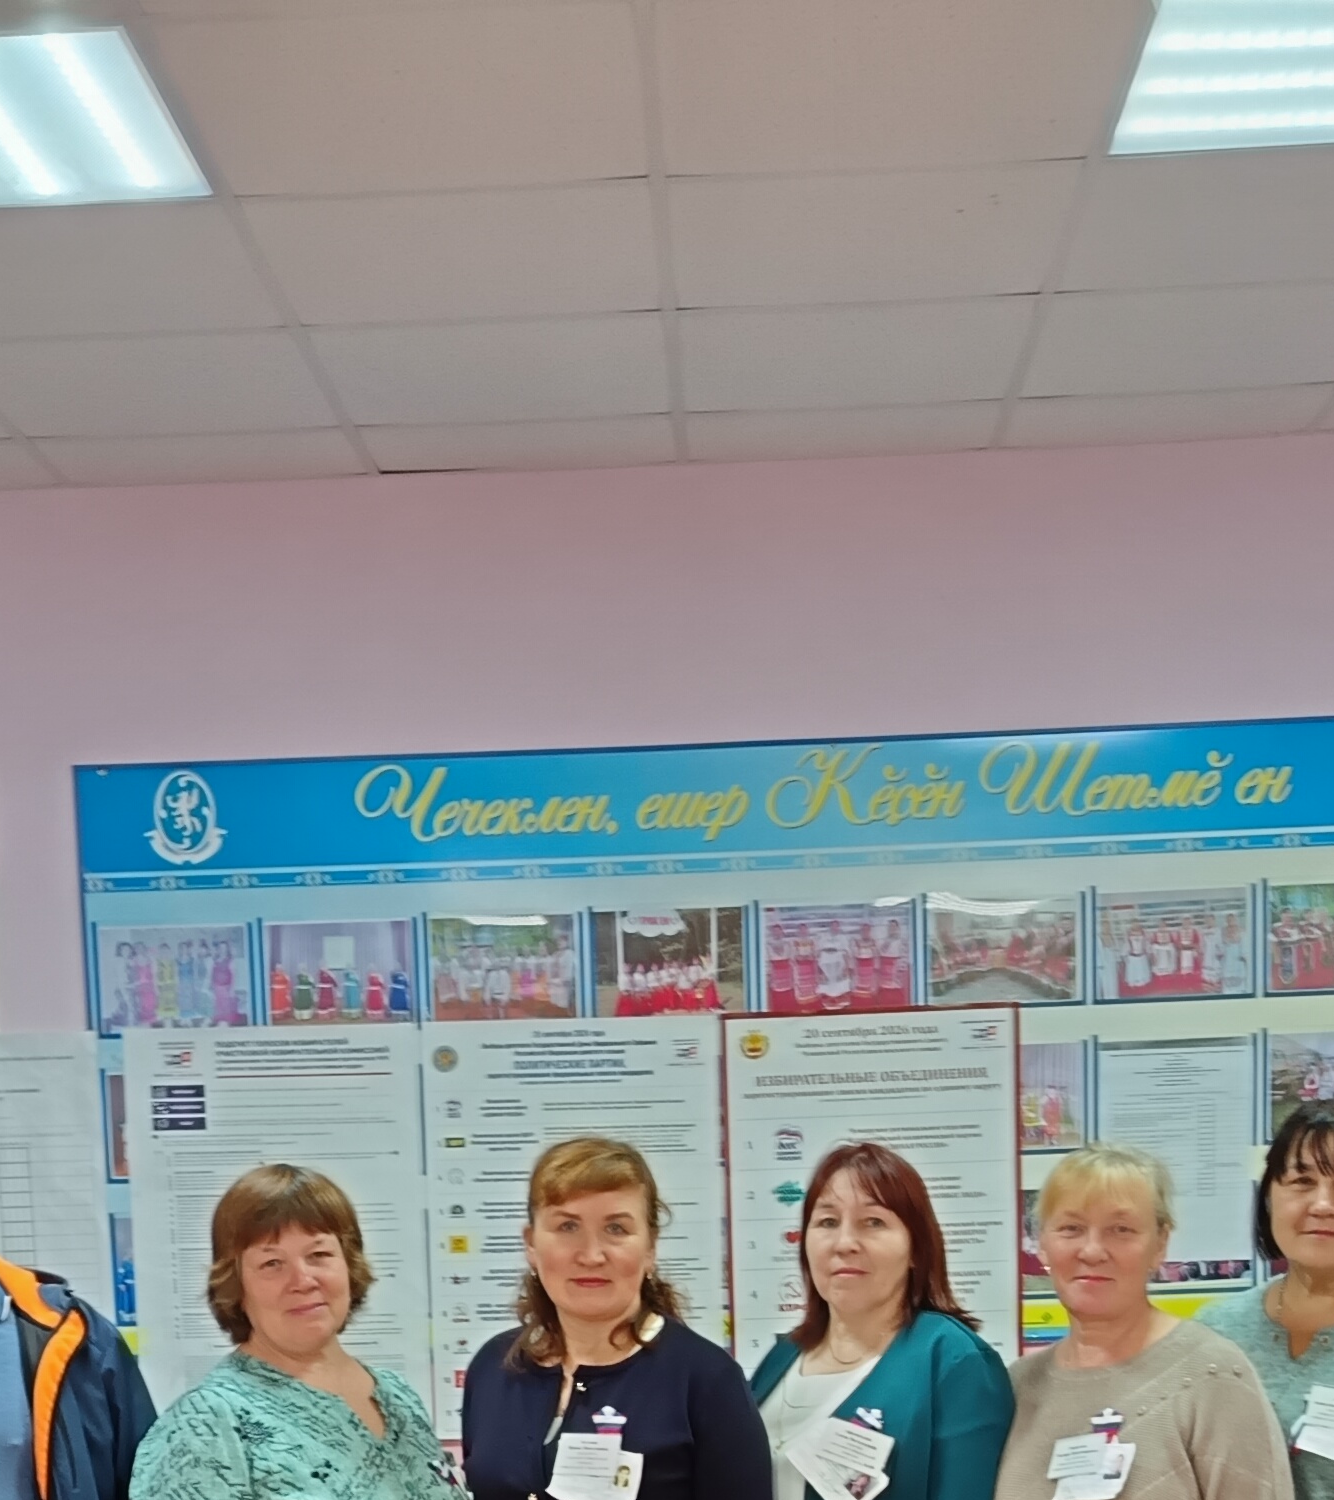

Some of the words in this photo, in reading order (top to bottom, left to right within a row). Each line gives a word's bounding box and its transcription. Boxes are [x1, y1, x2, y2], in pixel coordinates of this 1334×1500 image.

[354, 764, 619, 842] Чечеклен,
[635, 784, 750, 842] ешер
[756, 1071, 877, 1087] ИЗБИРАТЕЛЬНЫЕ
[880, 1066, 989, 1082] ОБЪЕДИНЕНИЯ
